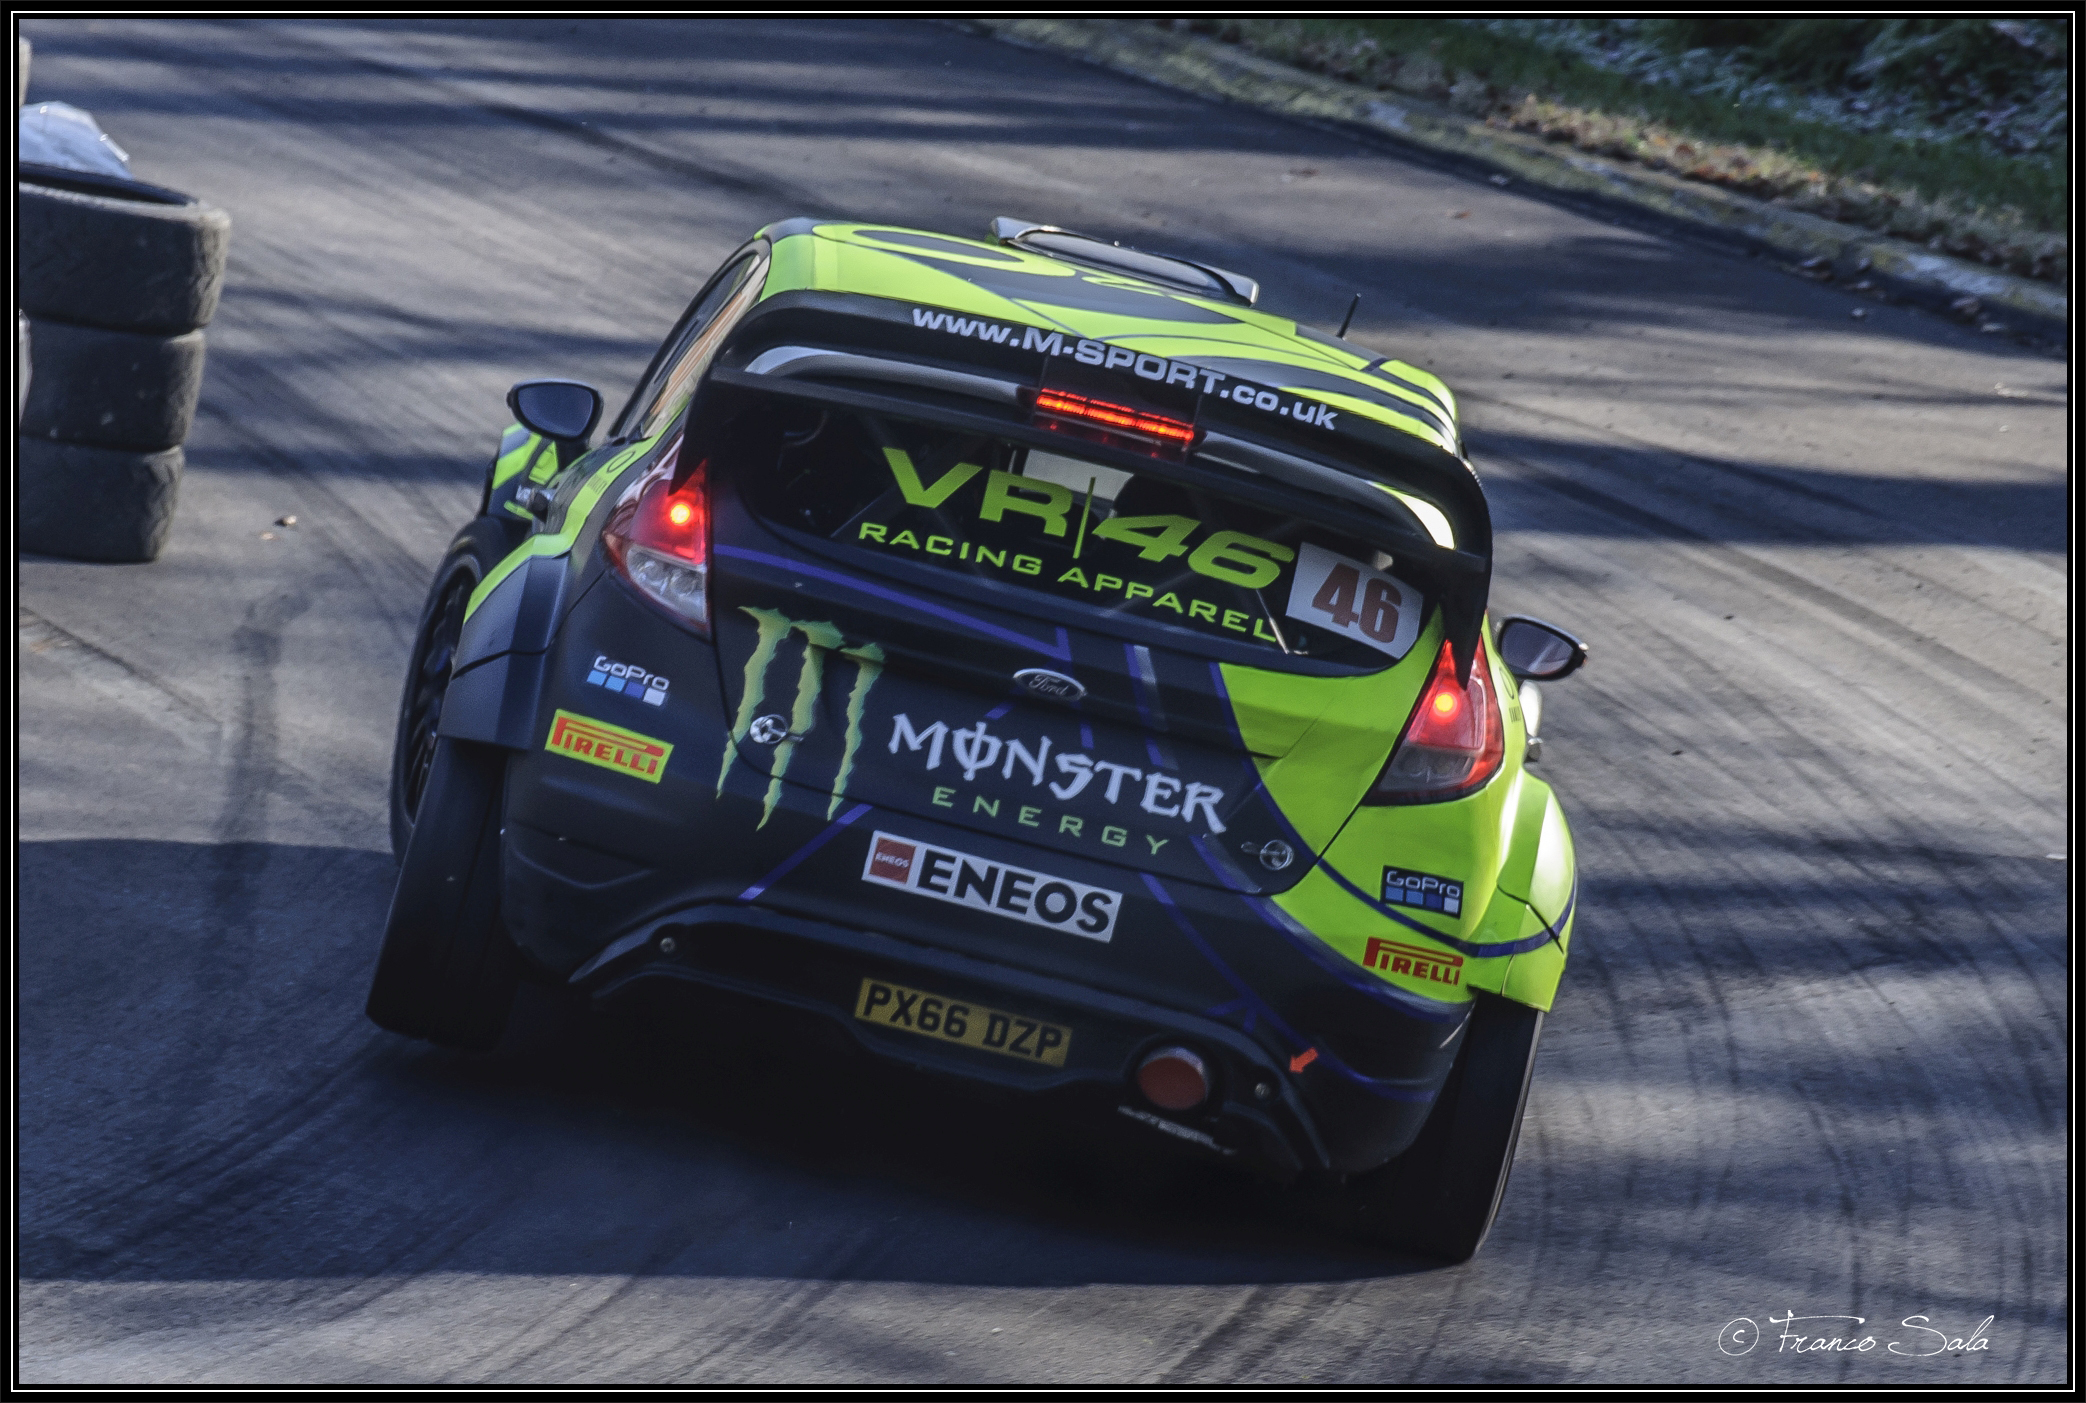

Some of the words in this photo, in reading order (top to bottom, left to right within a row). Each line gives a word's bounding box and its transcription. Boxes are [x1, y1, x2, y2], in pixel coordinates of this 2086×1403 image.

[859, 522, 1043, 576] RACING
[1057, 566, 1278, 643] APPAREL
[1311, 562, 1402, 646] 46
[593, 655, 670, 691] GoPro
[1028, 674, 1069, 695] Ford
[551, 716, 665, 775] PIRELLI
[932, 786, 1169, 855] ENERGY
[875, 852, 910, 869] ENEOS
[1386, 870, 1461, 898] GoPro
[917, 848, 1113, 933] ENEOS
[1362, 936, 1464, 986] PIRELLI
[863, 984, 970, 1038] PX66
[982, 1013, 1063, 1058] DZP
